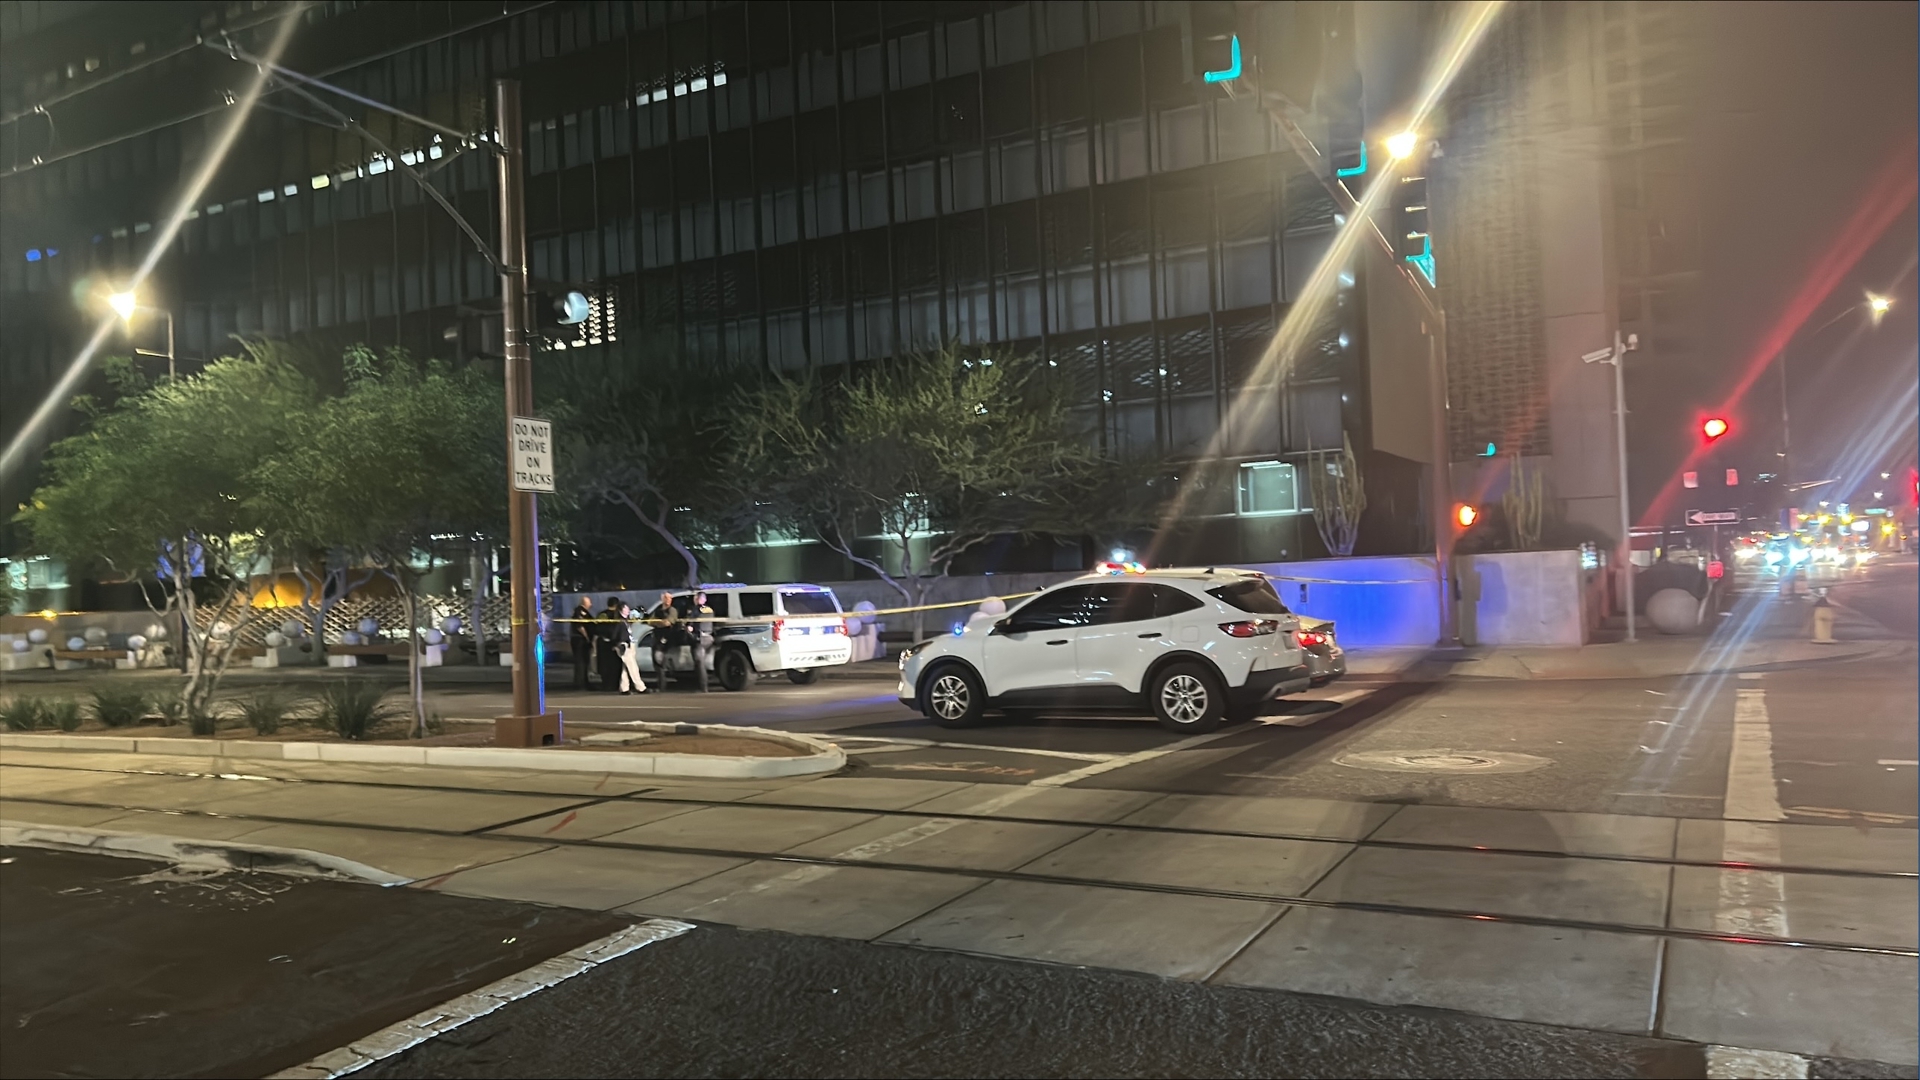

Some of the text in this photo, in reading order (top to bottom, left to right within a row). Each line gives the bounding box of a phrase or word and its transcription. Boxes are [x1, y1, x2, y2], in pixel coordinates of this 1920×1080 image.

[515, 423, 549, 438] DO NOT
[518, 439, 547, 454] DRIVE
[526, 456, 541, 468] ON
[515, 471, 553, 486] TRACKS
